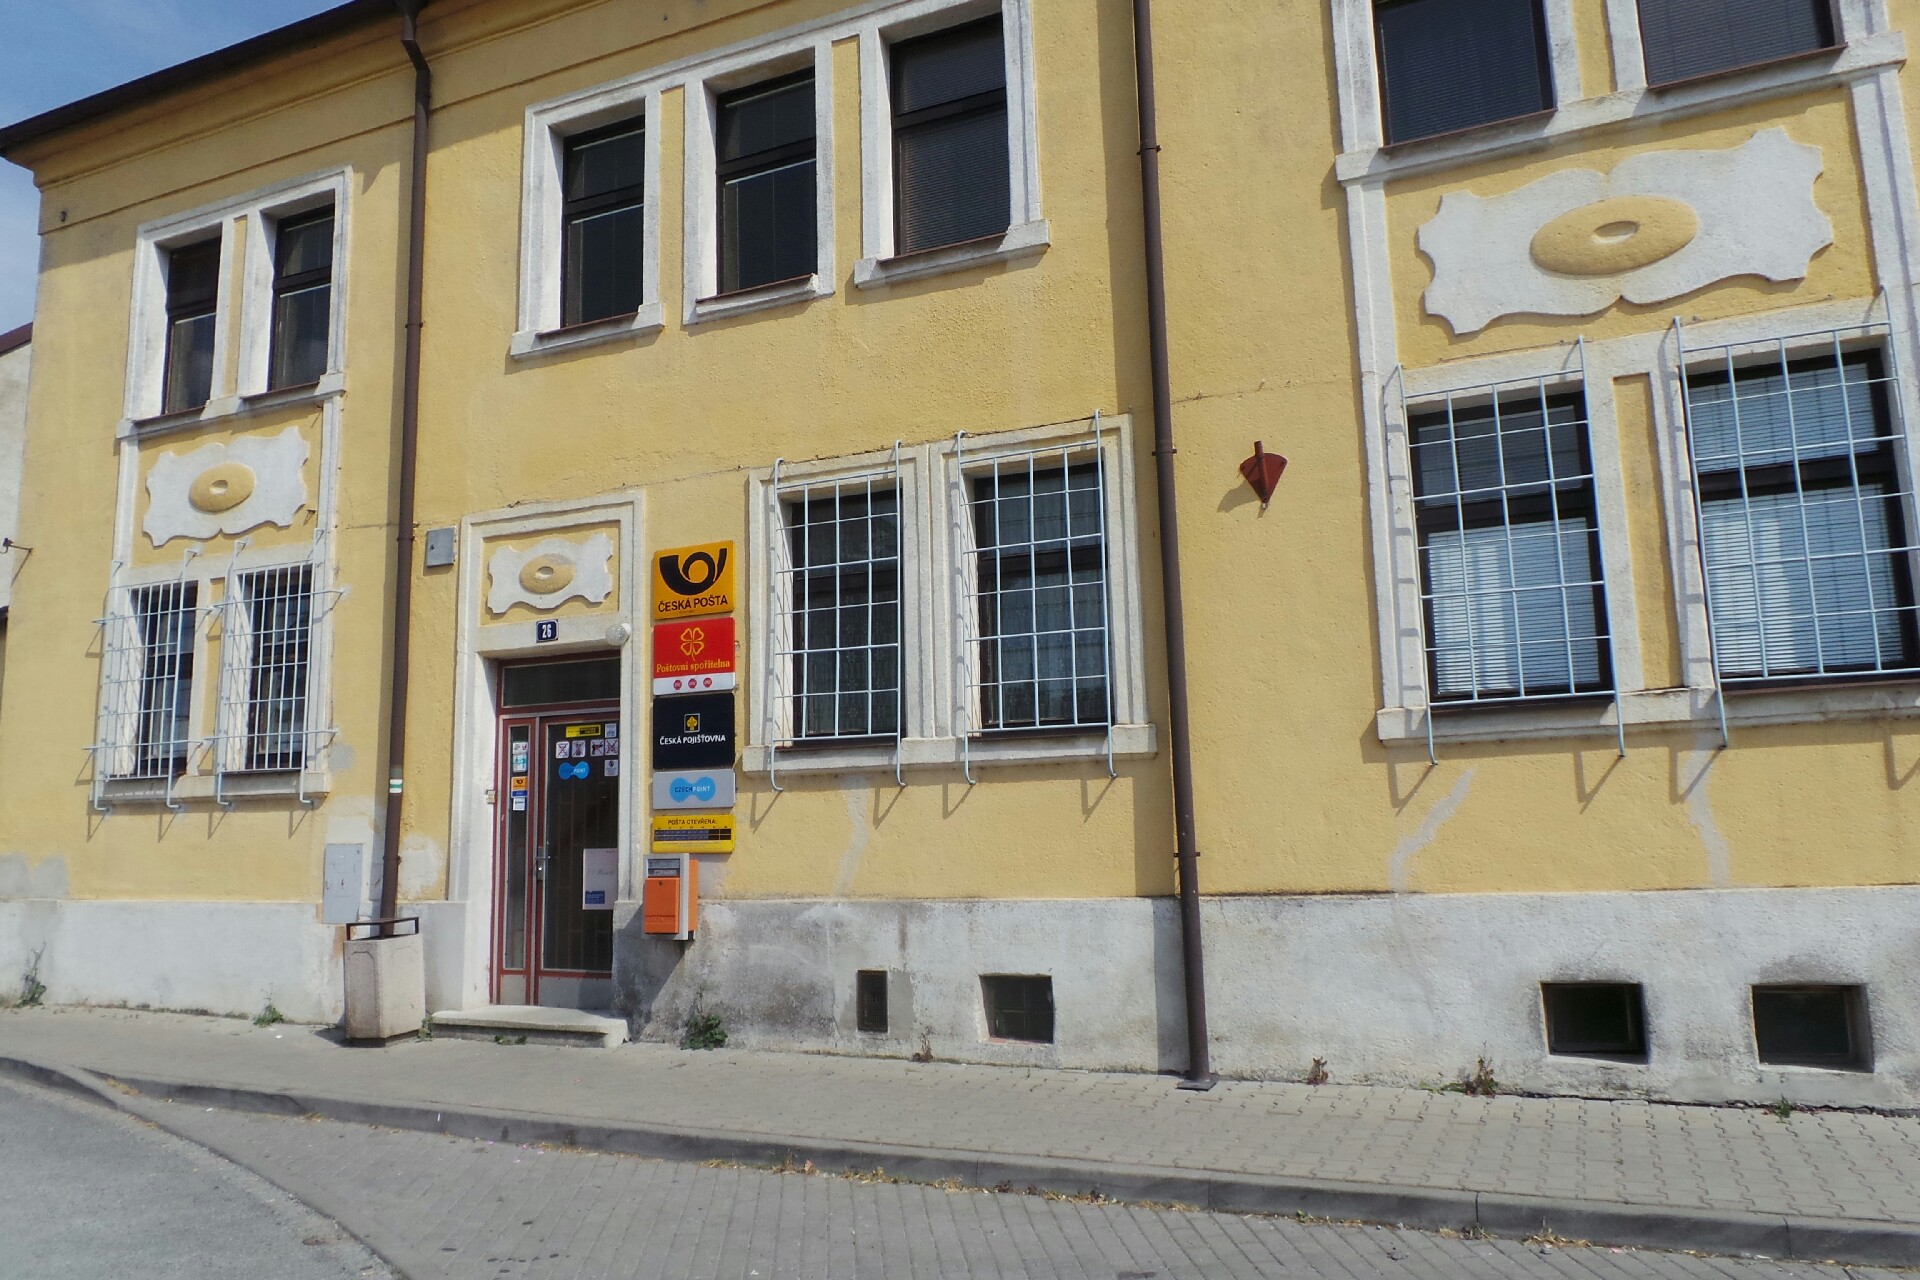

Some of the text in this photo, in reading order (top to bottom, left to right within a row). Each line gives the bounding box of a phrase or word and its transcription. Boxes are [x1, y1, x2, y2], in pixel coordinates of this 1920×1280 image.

[658, 595, 728, 612] ČESKÁ POŠTA
[542, 624, 551, 638] 26
[656, 659, 730, 673] Poštovní spořitelna
[659, 734, 726, 745] ČESKÁ POJIŠŤOVNA
